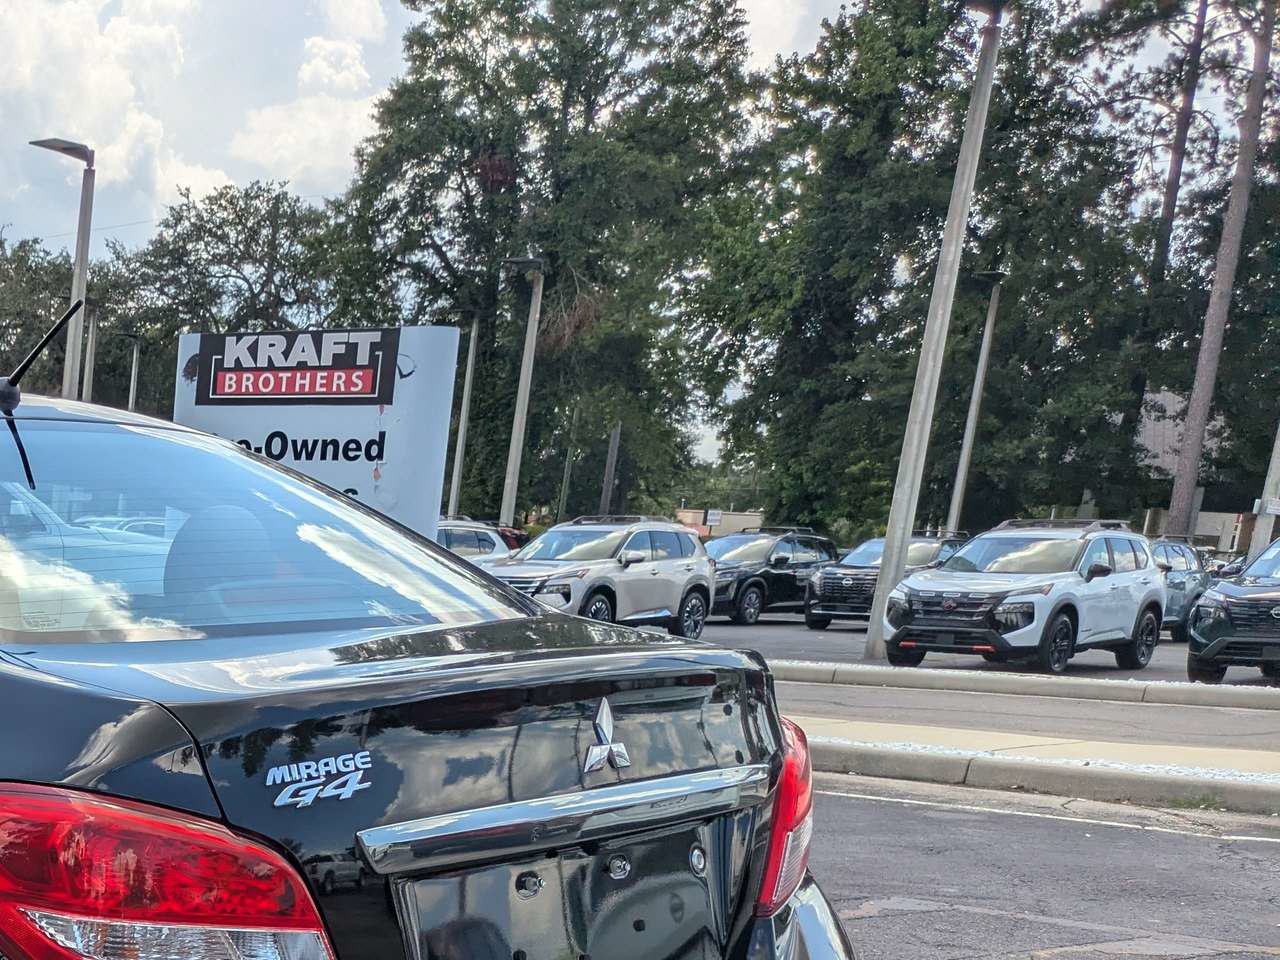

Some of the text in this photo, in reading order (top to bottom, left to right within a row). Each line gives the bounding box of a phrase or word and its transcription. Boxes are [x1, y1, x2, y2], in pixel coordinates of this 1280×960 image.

[223, 331, 382, 368] KRAFT
[223, 371, 364, 393] BROTHERS
[265, 751, 373, 785] MIRAGE
[273, 769, 372, 808] G4
